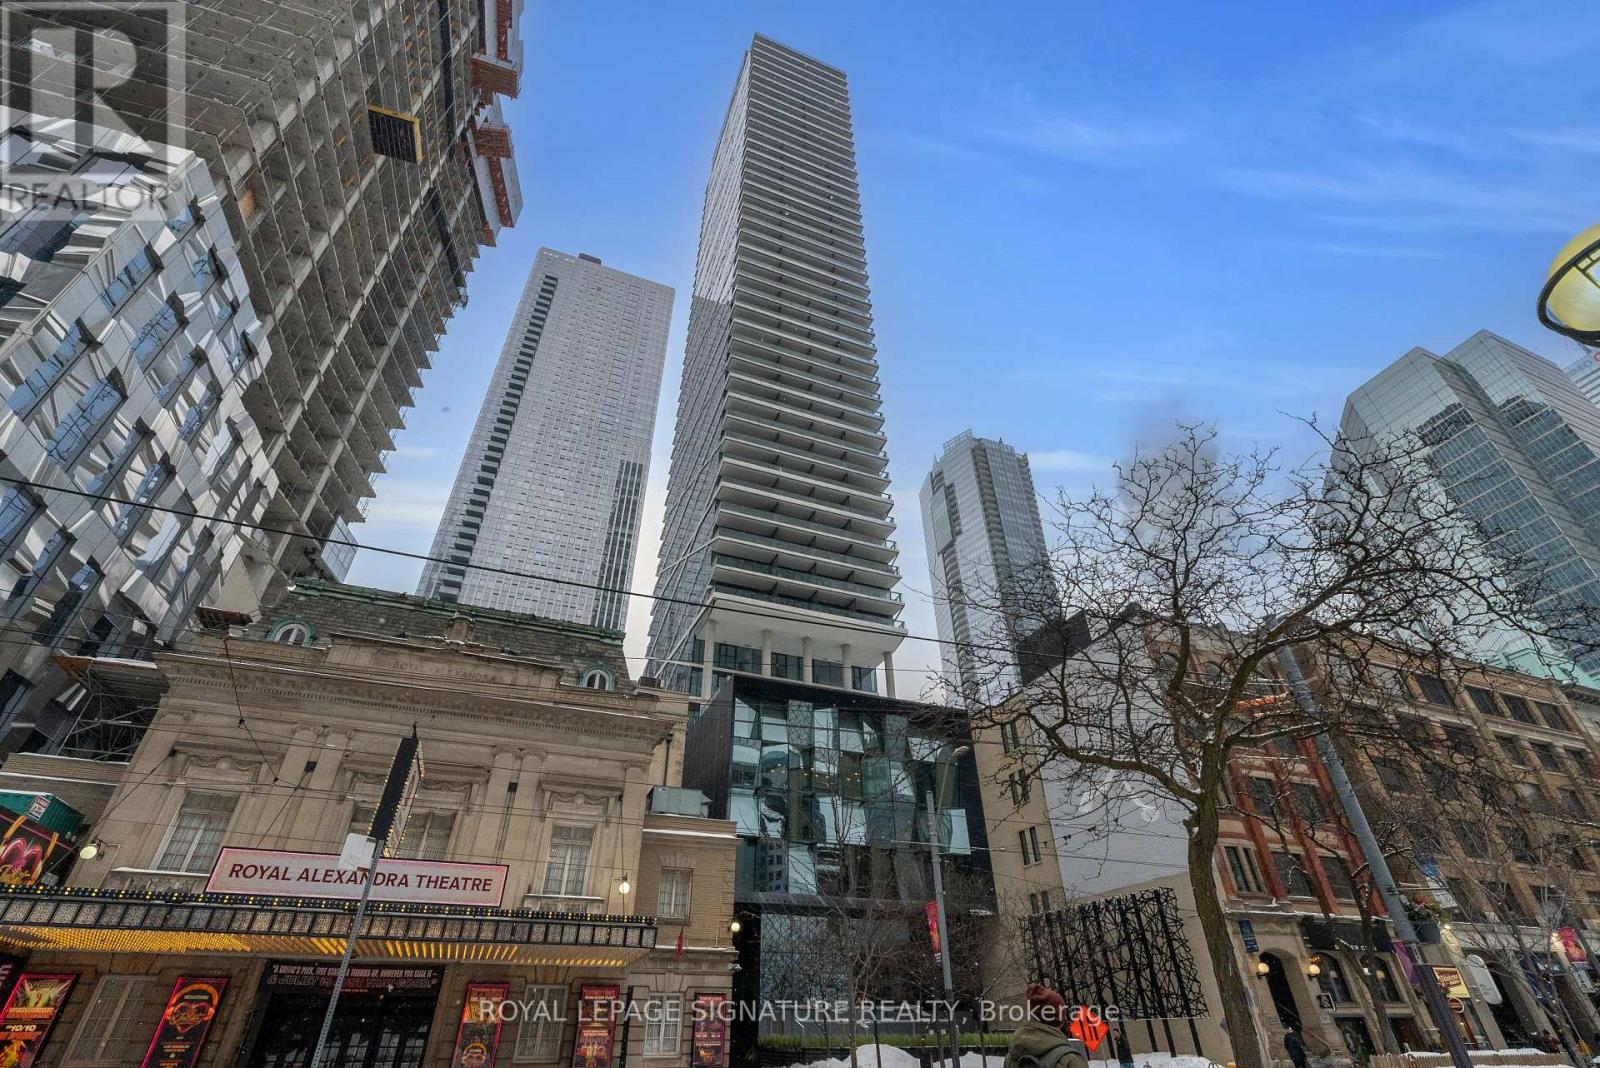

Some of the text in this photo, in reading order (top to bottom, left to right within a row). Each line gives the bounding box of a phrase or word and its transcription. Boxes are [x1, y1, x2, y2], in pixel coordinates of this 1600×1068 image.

[228, 863, 493, 892] ROYAL ALEXANDRA THEATRE
